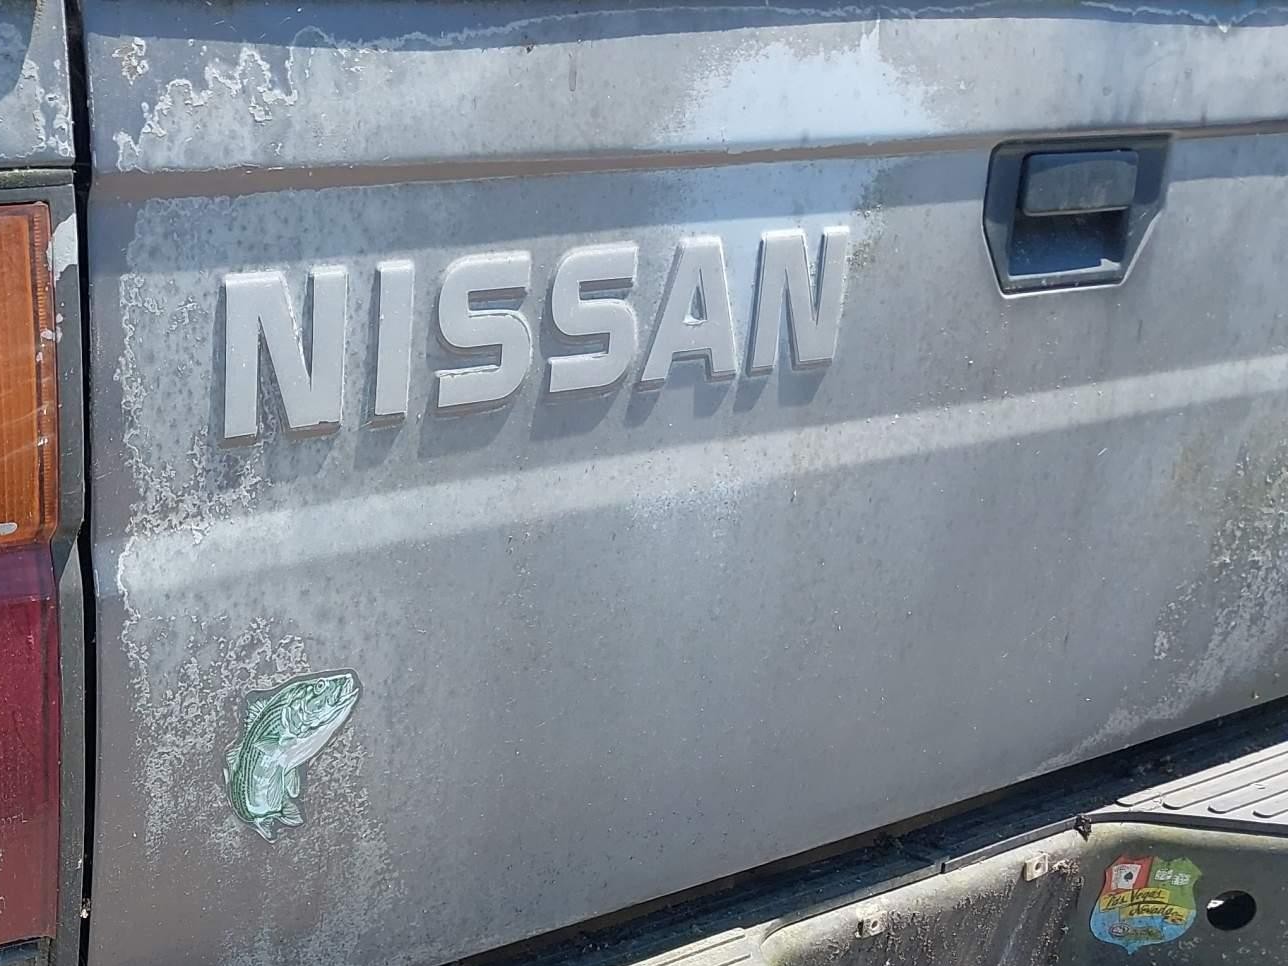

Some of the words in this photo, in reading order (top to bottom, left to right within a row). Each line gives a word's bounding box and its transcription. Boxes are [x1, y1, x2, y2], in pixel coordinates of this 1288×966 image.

[221, 225, 849, 446] NISSAN
[1130, 888, 1165, 902] Vegas
[1128, 903, 1173, 917] Nevada
